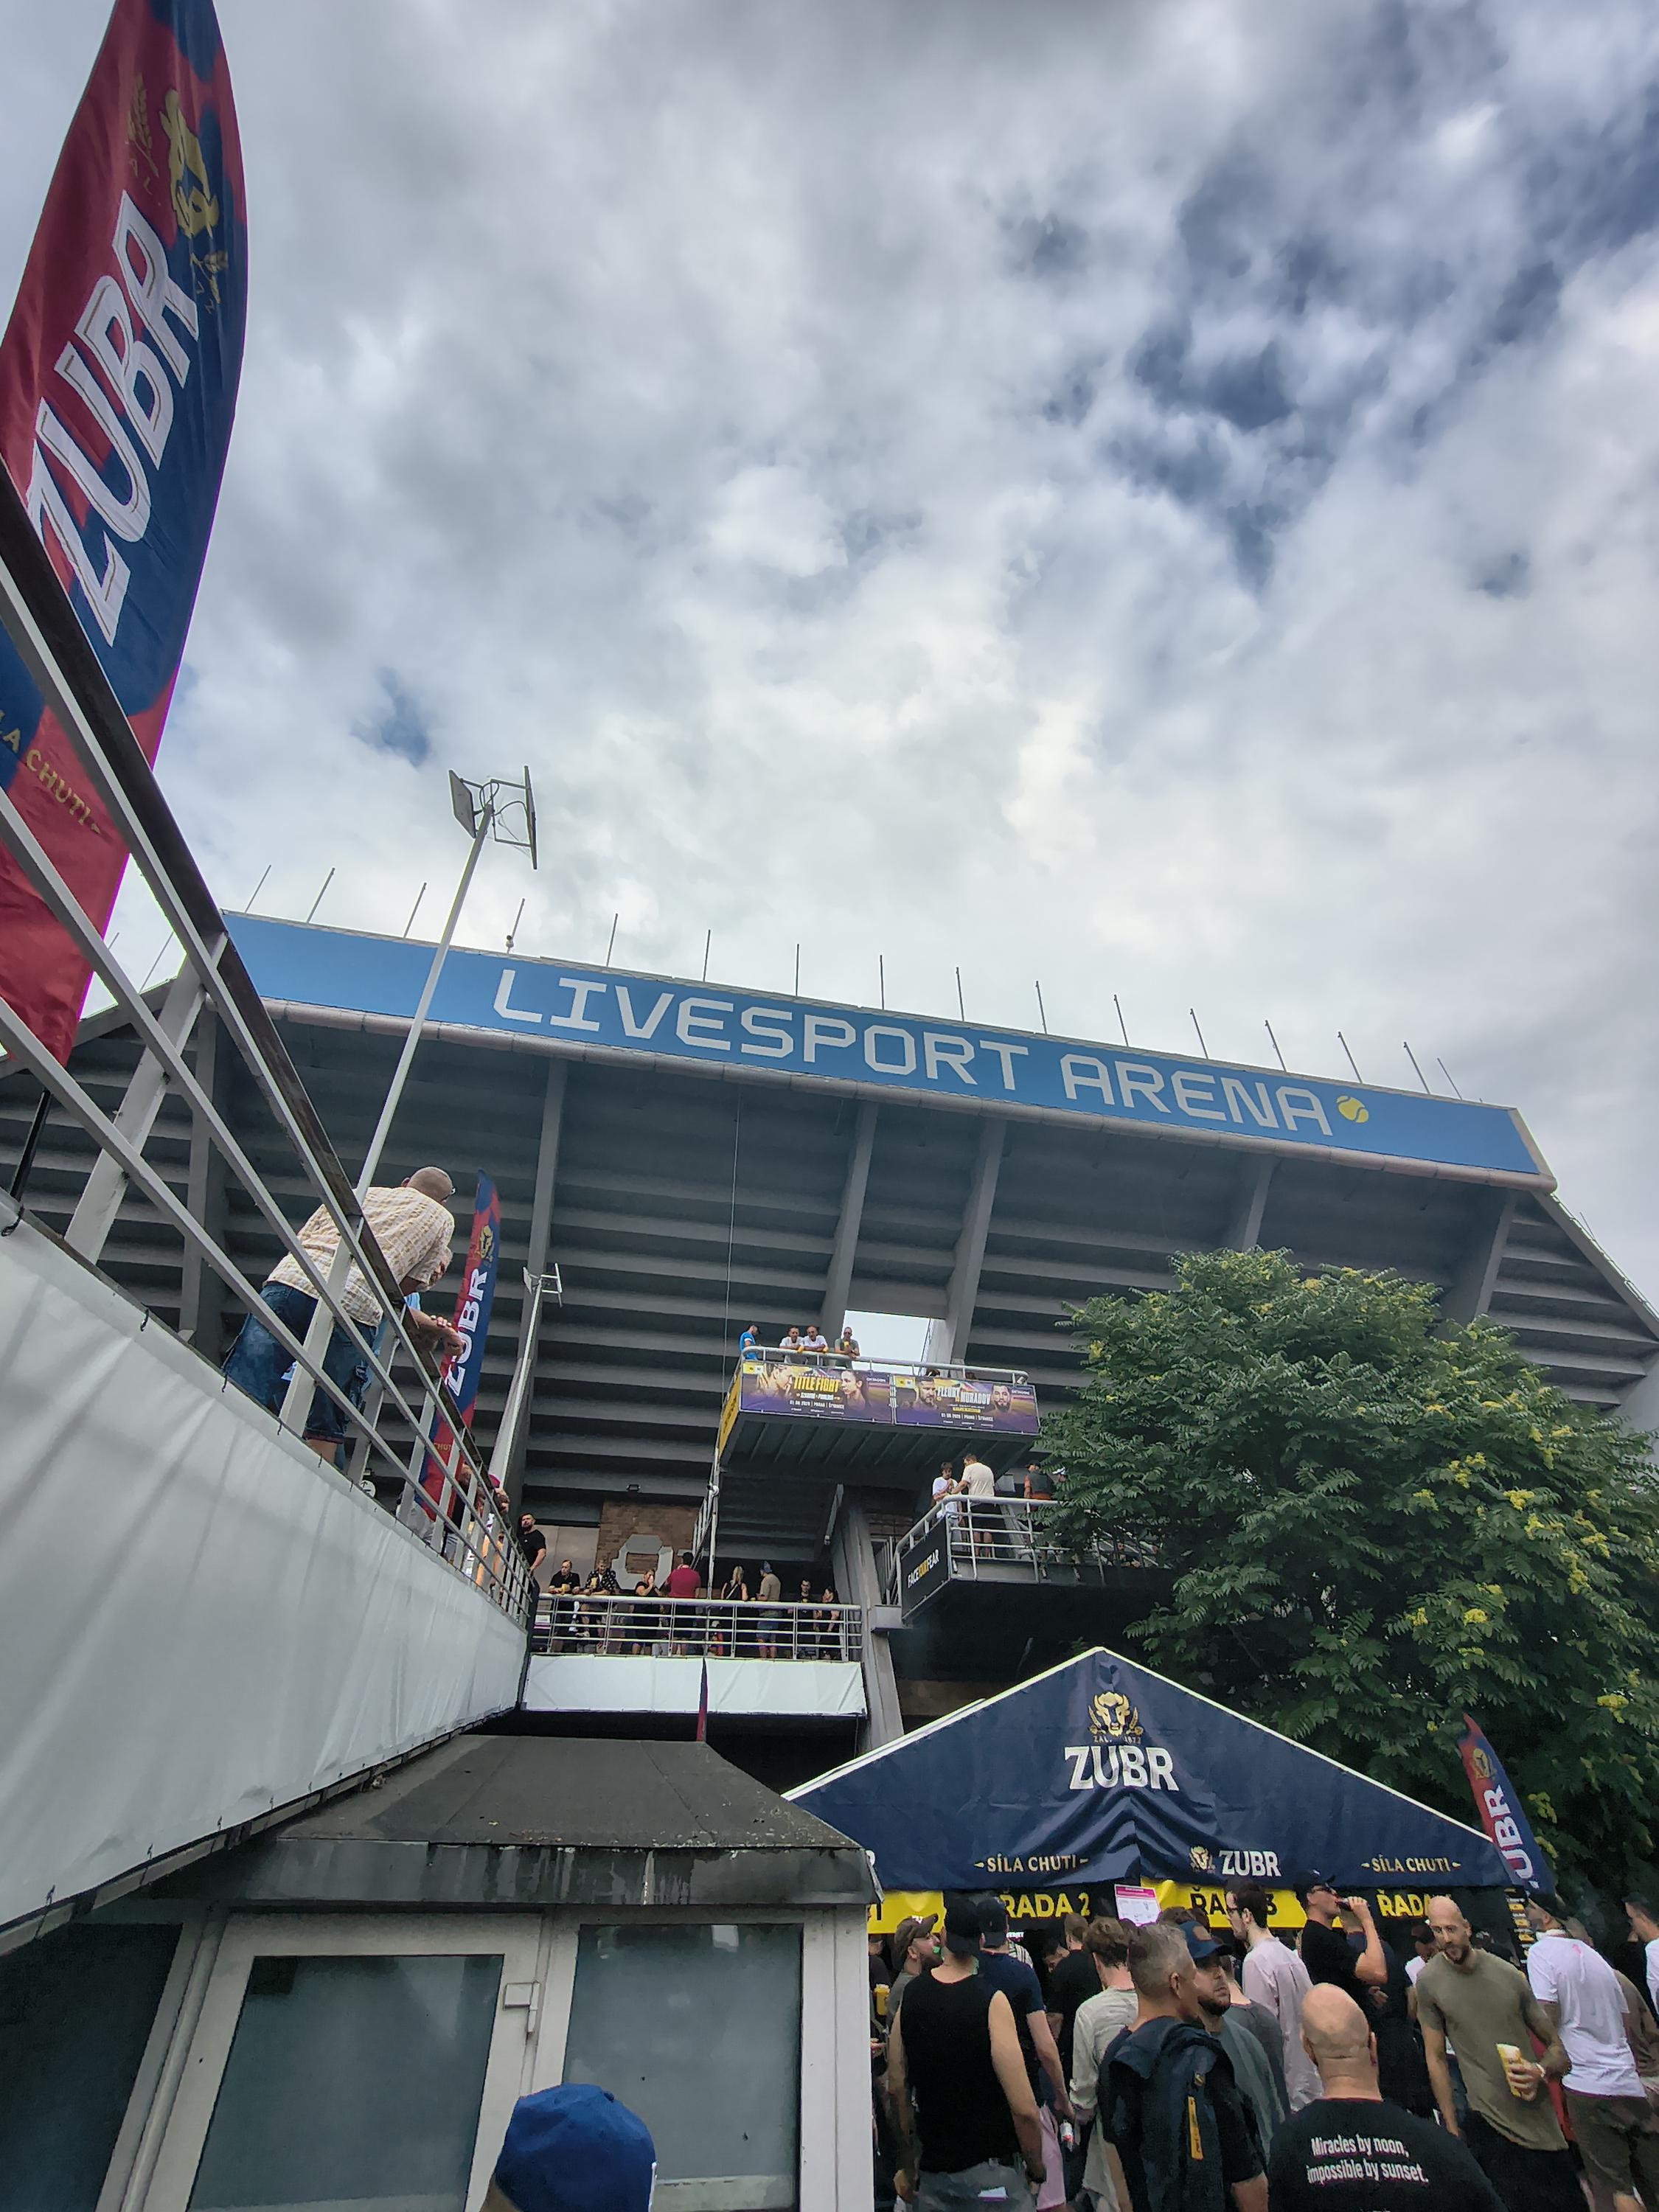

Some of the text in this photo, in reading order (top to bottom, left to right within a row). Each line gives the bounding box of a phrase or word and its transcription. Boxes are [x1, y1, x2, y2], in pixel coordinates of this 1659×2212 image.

[26, 189, 199, 647] ZUBR
[27, 749, 91, 825] CHUTI
[493, 969, 1333, 1136] LIVESPORT ARENA
[444, 1268, 487, 1397] ZUBR
[794, 1376, 840, 1393] TITLE FIGHT
[1064, 1745, 1180, 1792] ZUBR
[1484, 1784, 1540, 1889] UBR
[987, 1853, 1077, 1873] SÍLA CHUTI
[1219, 1850, 1282, 1877] ZUBR
[1371, 1854, 1451, 1873] SÍLA CHUTI
[1078, 1892, 1091, 1917] 2
[1190, 1886, 1227, 1916] ŘA
[1311, 2133, 1410, 2158] Miracles by noon,
[1306, 2158, 1429, 2185] impossible by sunset.
